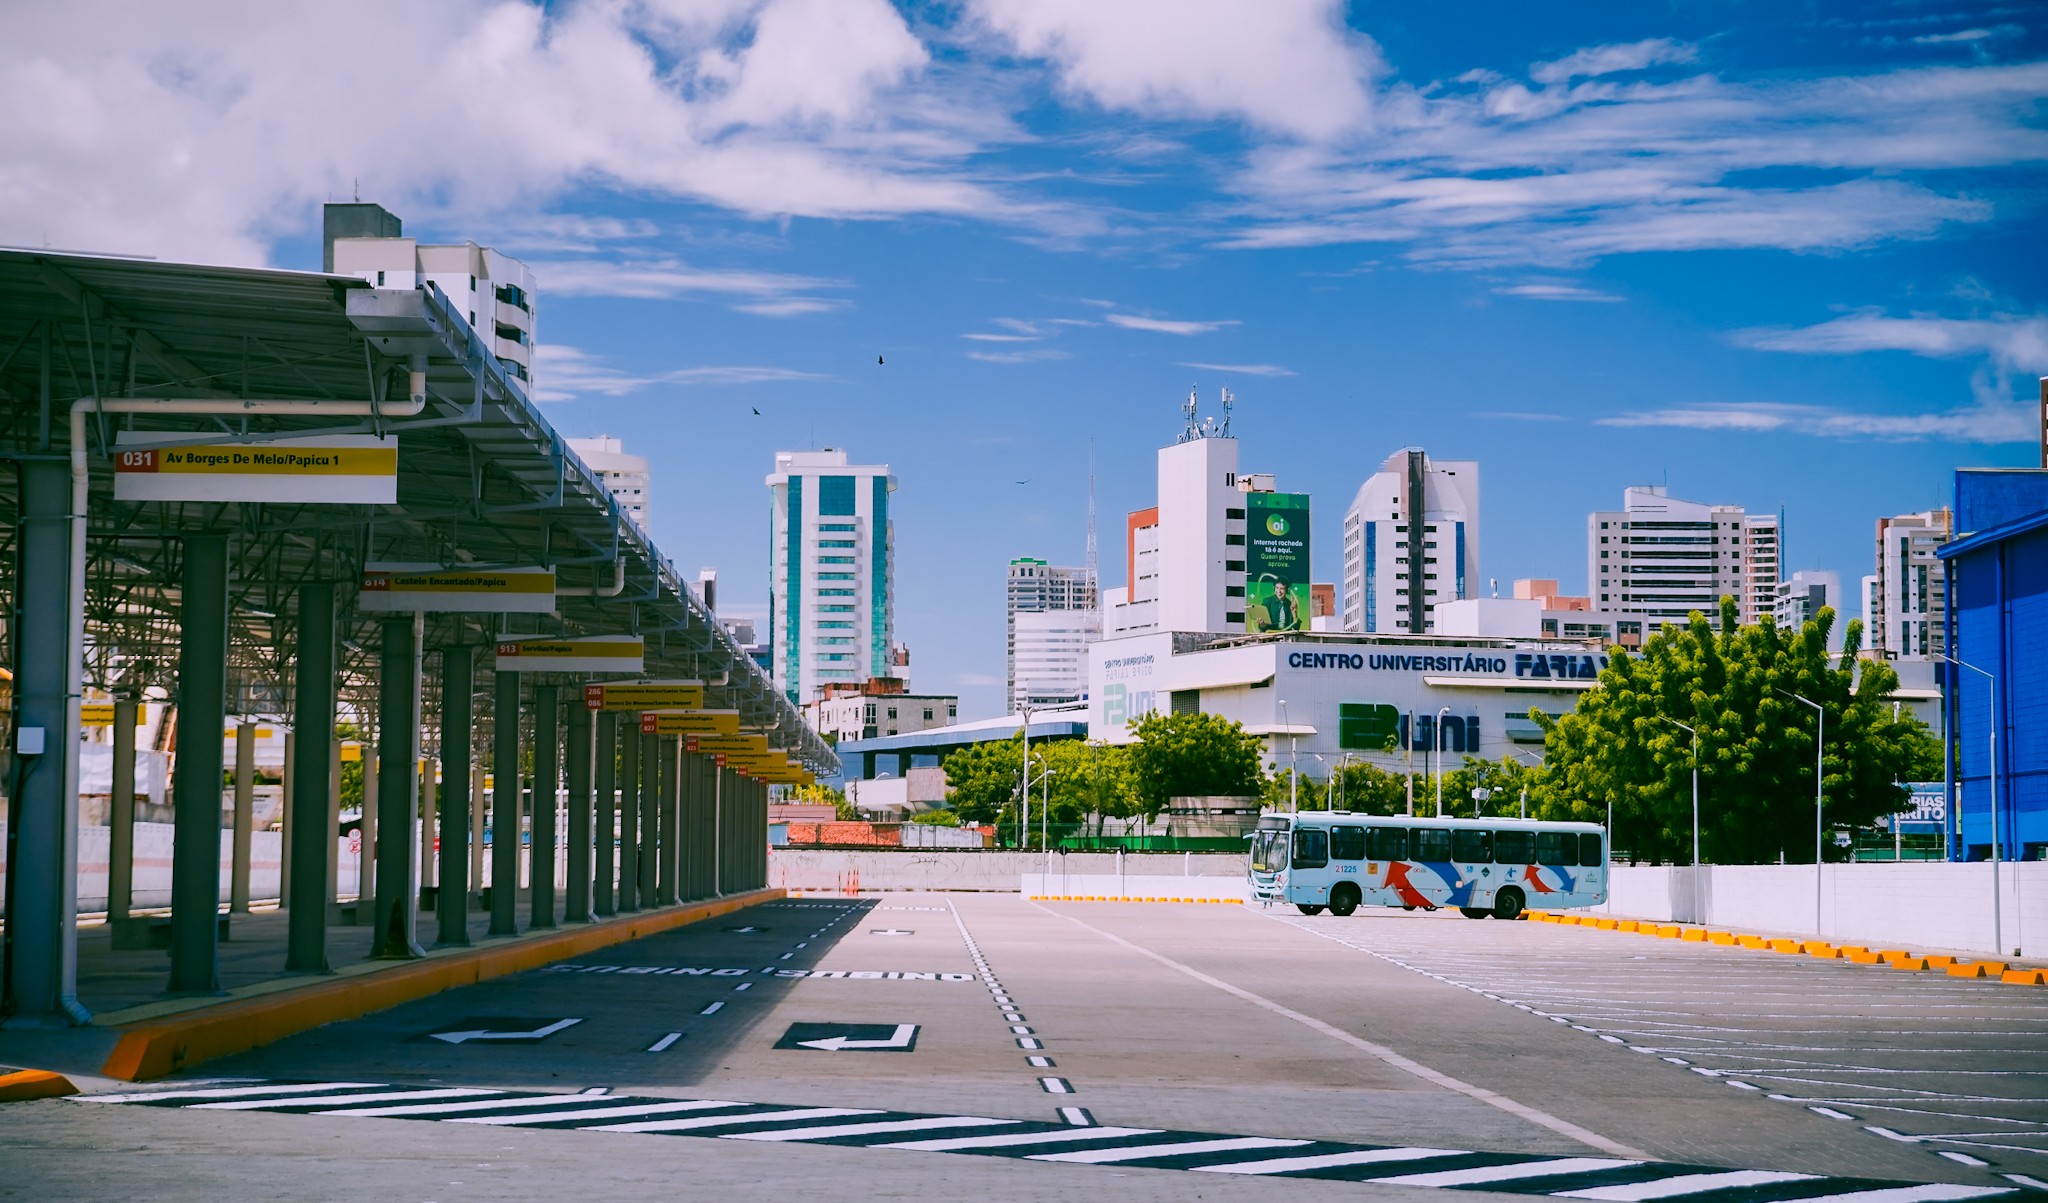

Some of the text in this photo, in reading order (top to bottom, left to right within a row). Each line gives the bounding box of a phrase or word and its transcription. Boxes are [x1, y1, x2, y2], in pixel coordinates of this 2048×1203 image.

[123, 450, 339, 468] 031 Av Borges De Melo/Papicu 1
[1272, 518, 1284, 531] oi
[394, 577, 427, 586] Castelo
[429, 577, 506, 588] Encantado/Papicu
[500, 644, 516, 653] 913
[1288, 652, 1364, 670] CENTRO
[1369, 652, 1506, 673] UNIVERSITÁRIO
[1335, 865, 1357, 873] 21225
